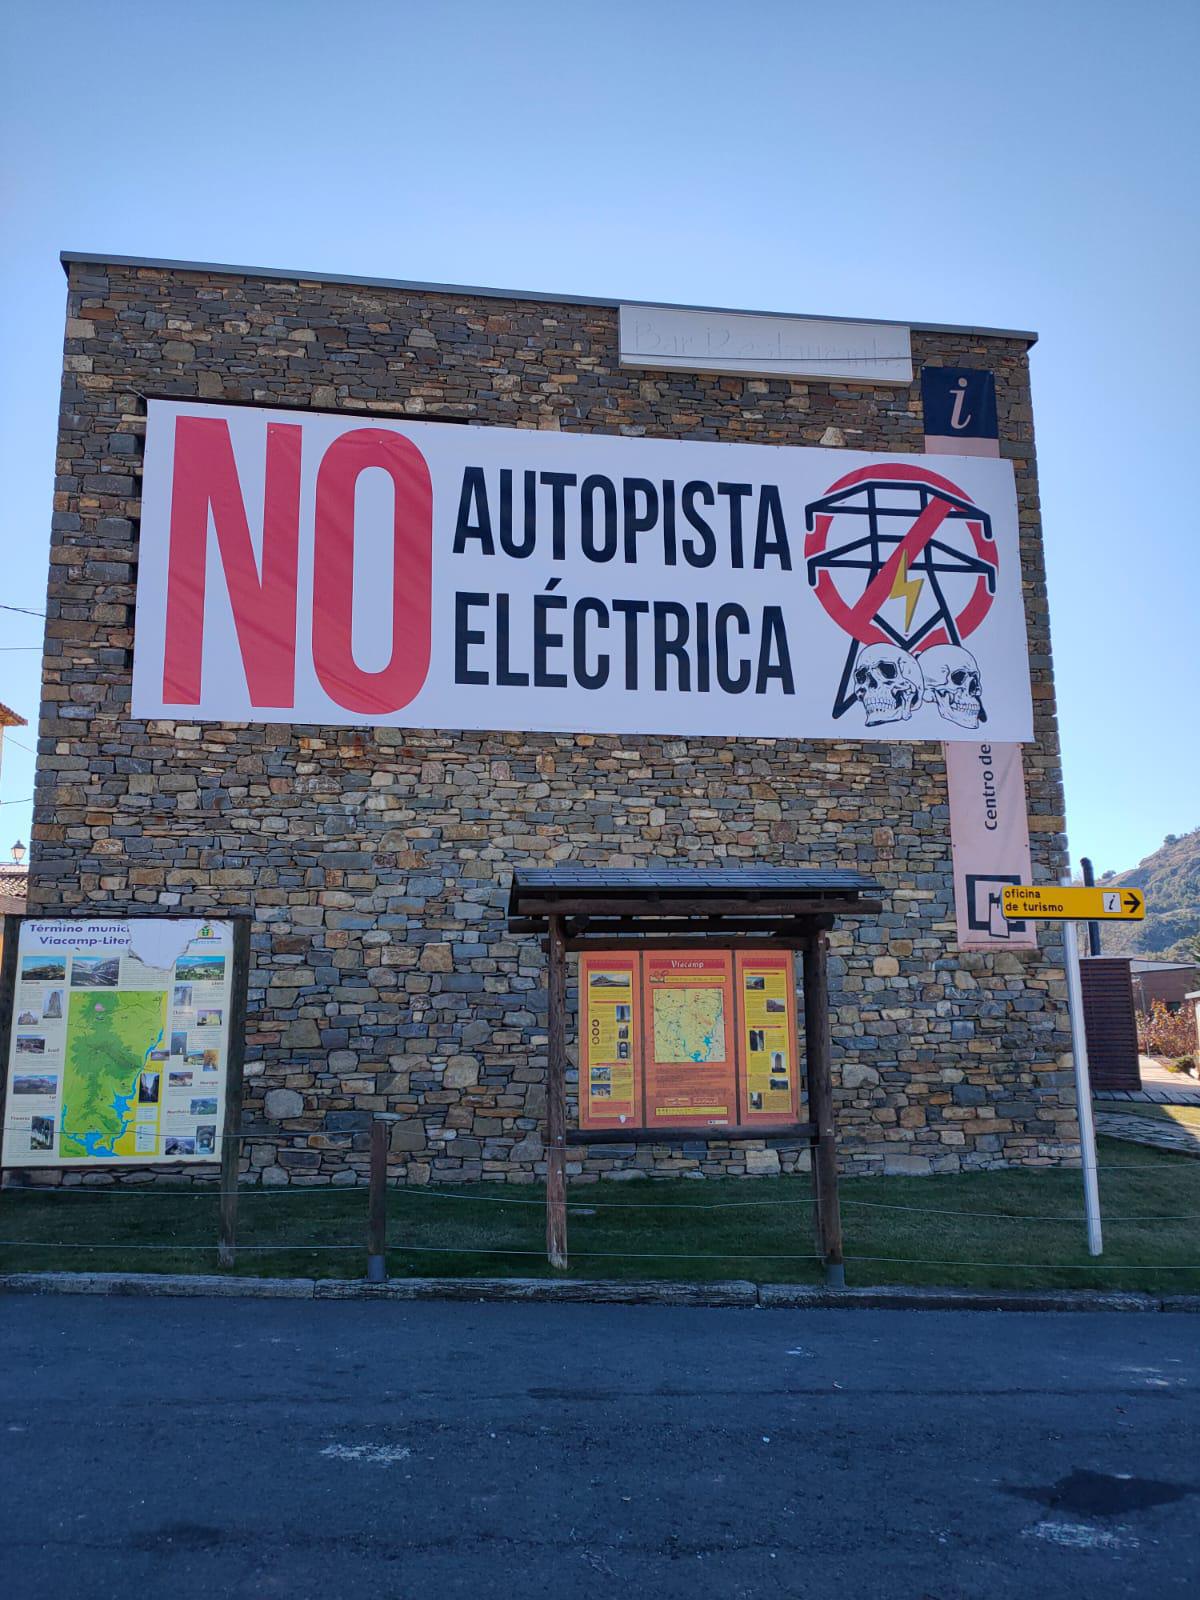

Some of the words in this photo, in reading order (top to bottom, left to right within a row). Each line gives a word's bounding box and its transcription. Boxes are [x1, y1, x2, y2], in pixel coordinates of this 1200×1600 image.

[453, 466, 792, 571] AUTOPISTA
[163, 415, 433, 714] NO
[455, 577, 796, 695] ELÉCTRICA
[978, 743, 993, 766] de
[982, 770, 998, 831] Centro
[1004, 889, 1041, 899] oficina
[1005, 902, 1019, 912] de
[1023, 903, 1064, 912] turismo
